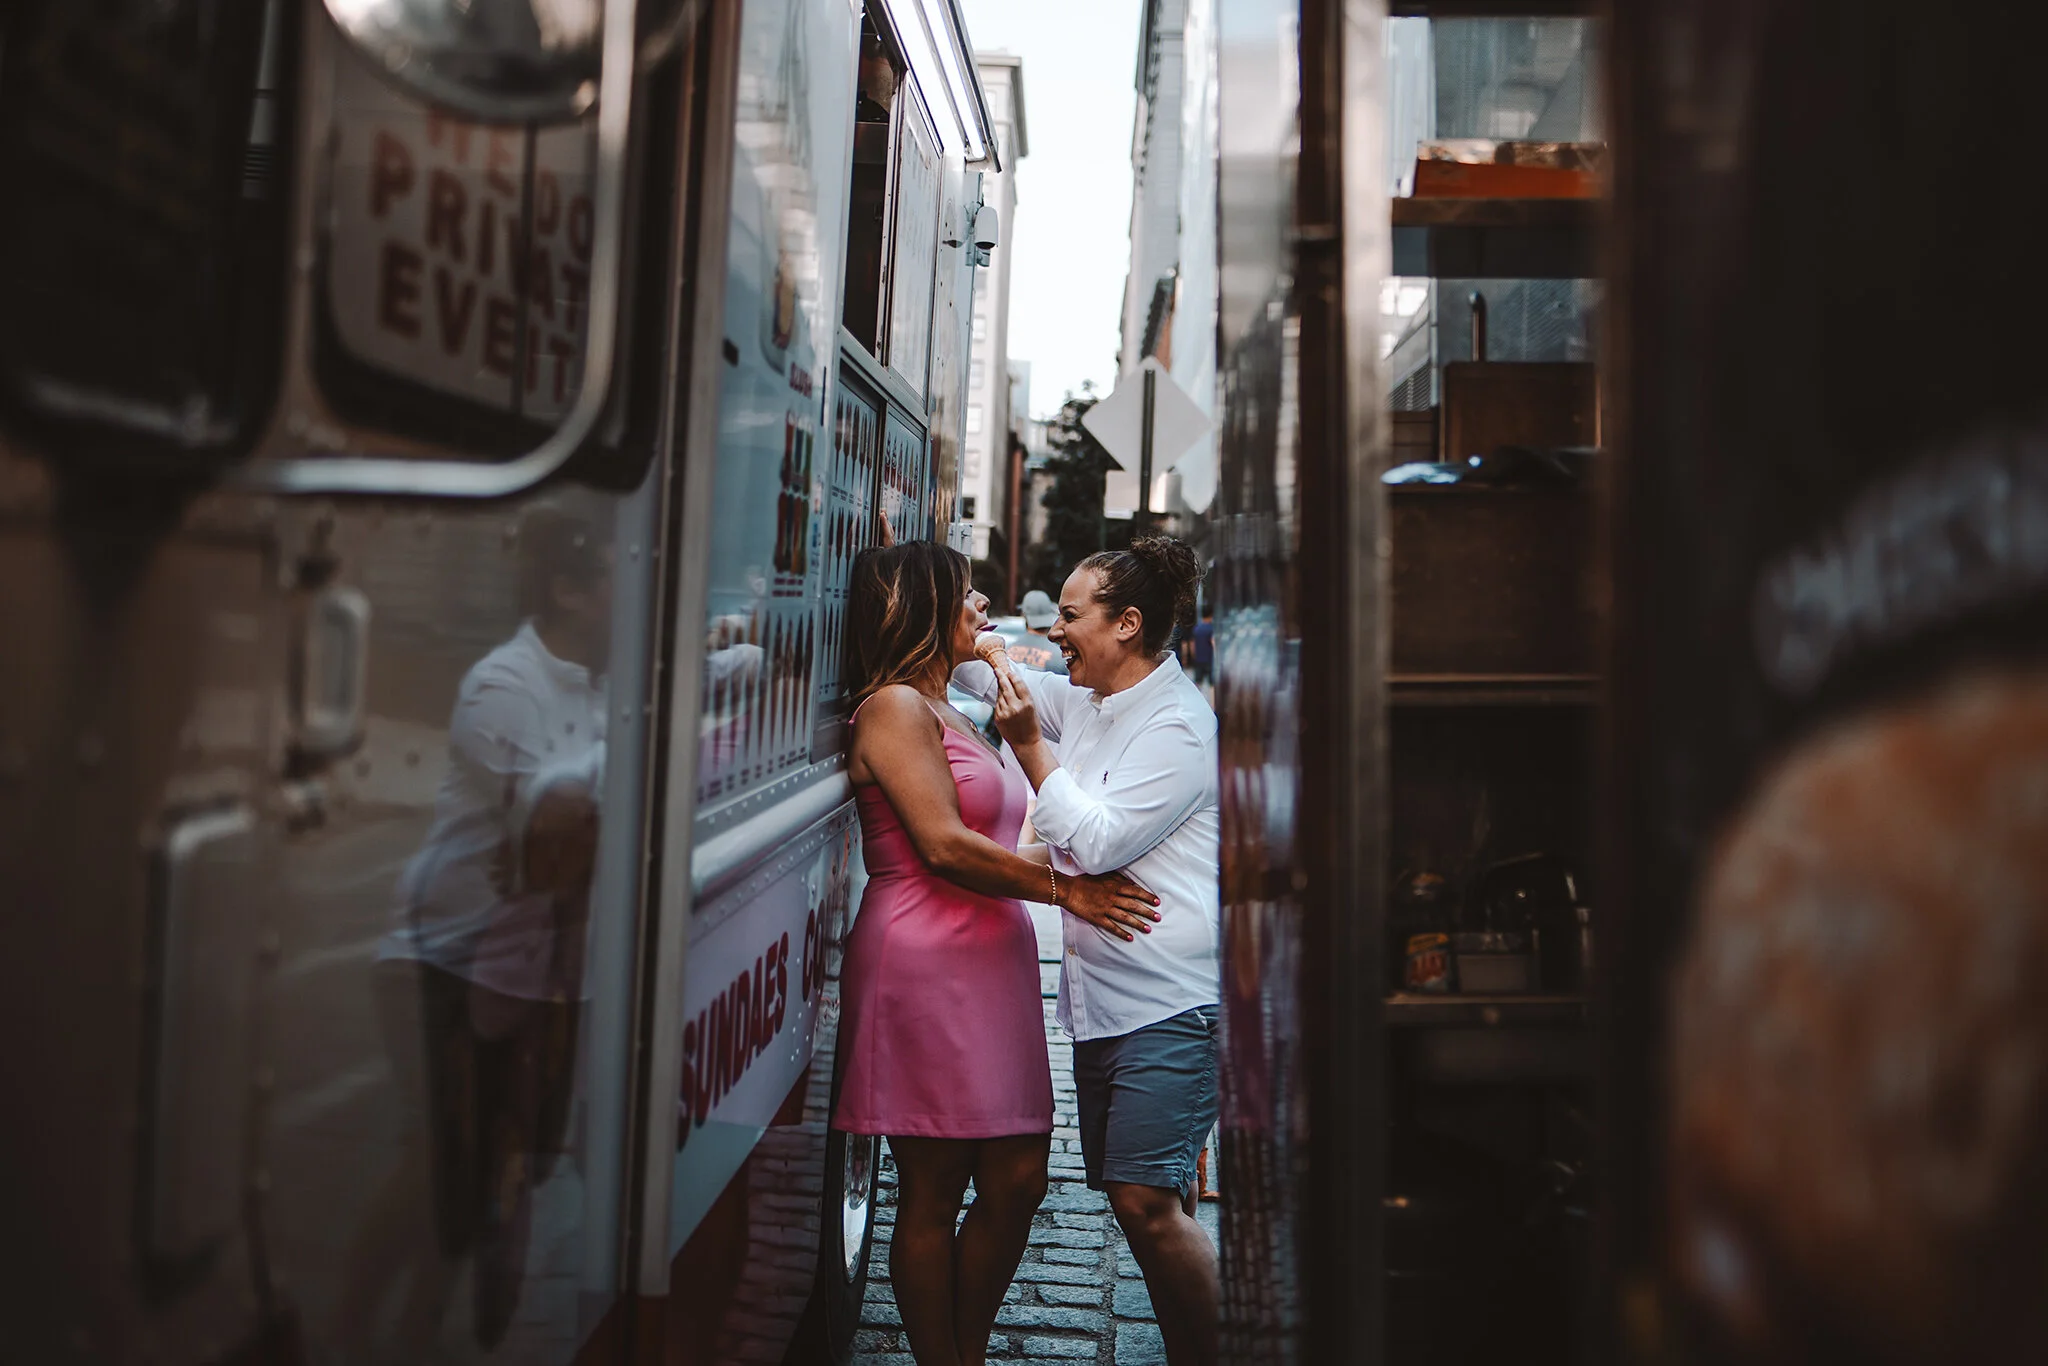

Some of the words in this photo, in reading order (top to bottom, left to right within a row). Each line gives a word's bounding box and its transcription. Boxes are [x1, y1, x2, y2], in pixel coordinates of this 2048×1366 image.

[368, 129, 590, 332] PRIVAT
[677, 931, 789, 1154] SUNDAES
[802, 899, 827, 1003] CO
